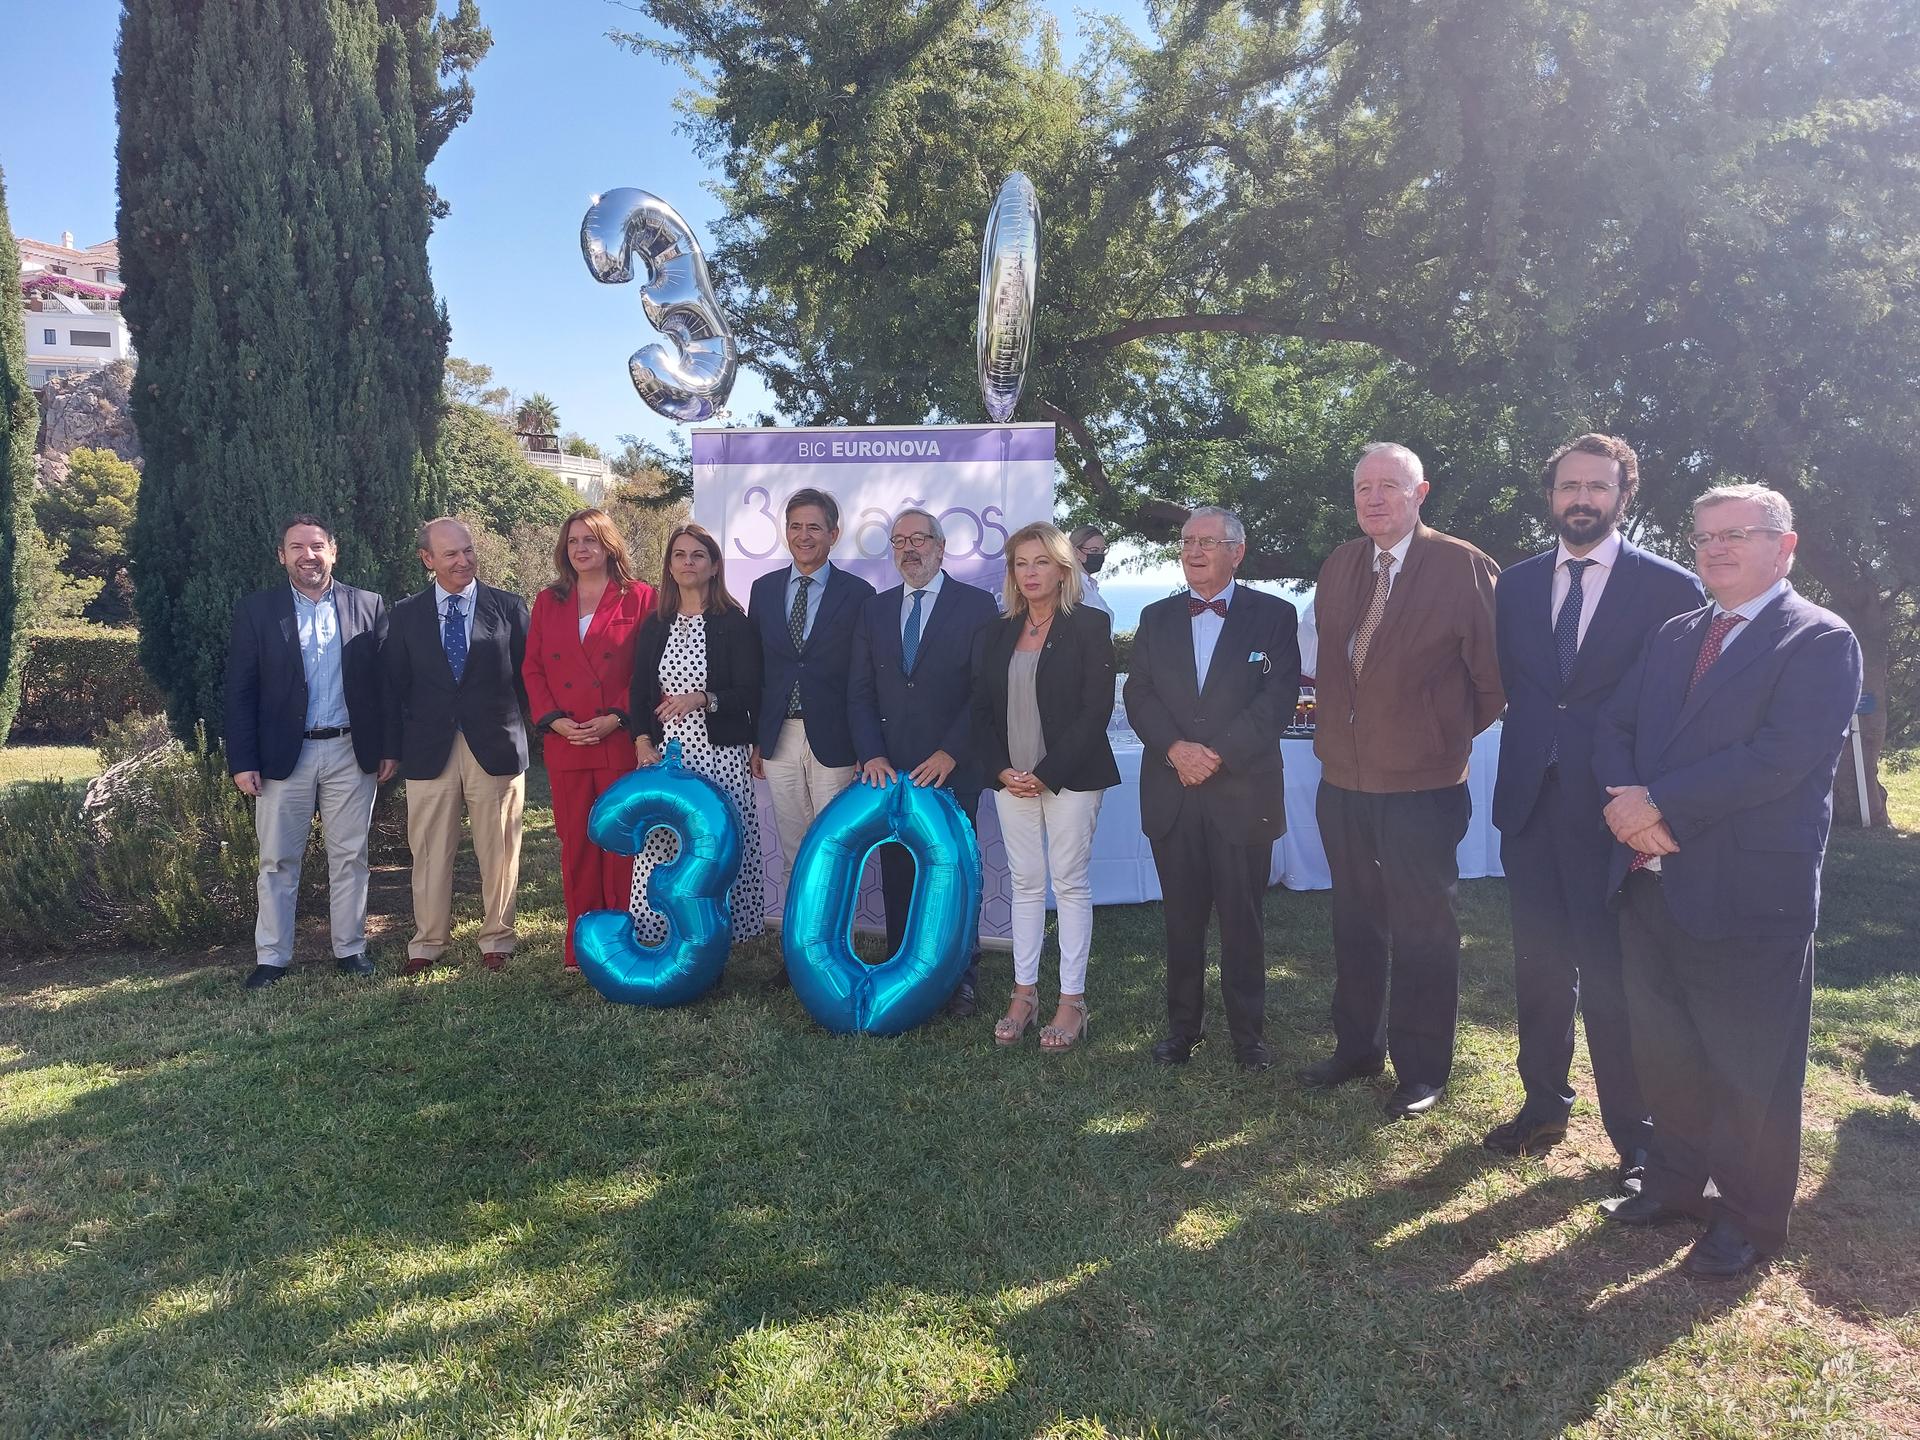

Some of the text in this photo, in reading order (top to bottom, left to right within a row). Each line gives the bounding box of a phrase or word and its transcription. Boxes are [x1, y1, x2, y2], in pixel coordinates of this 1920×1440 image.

[798, 440, 941, 457] BIC EURONOVA
[855, 496, 1009, 561] aos
